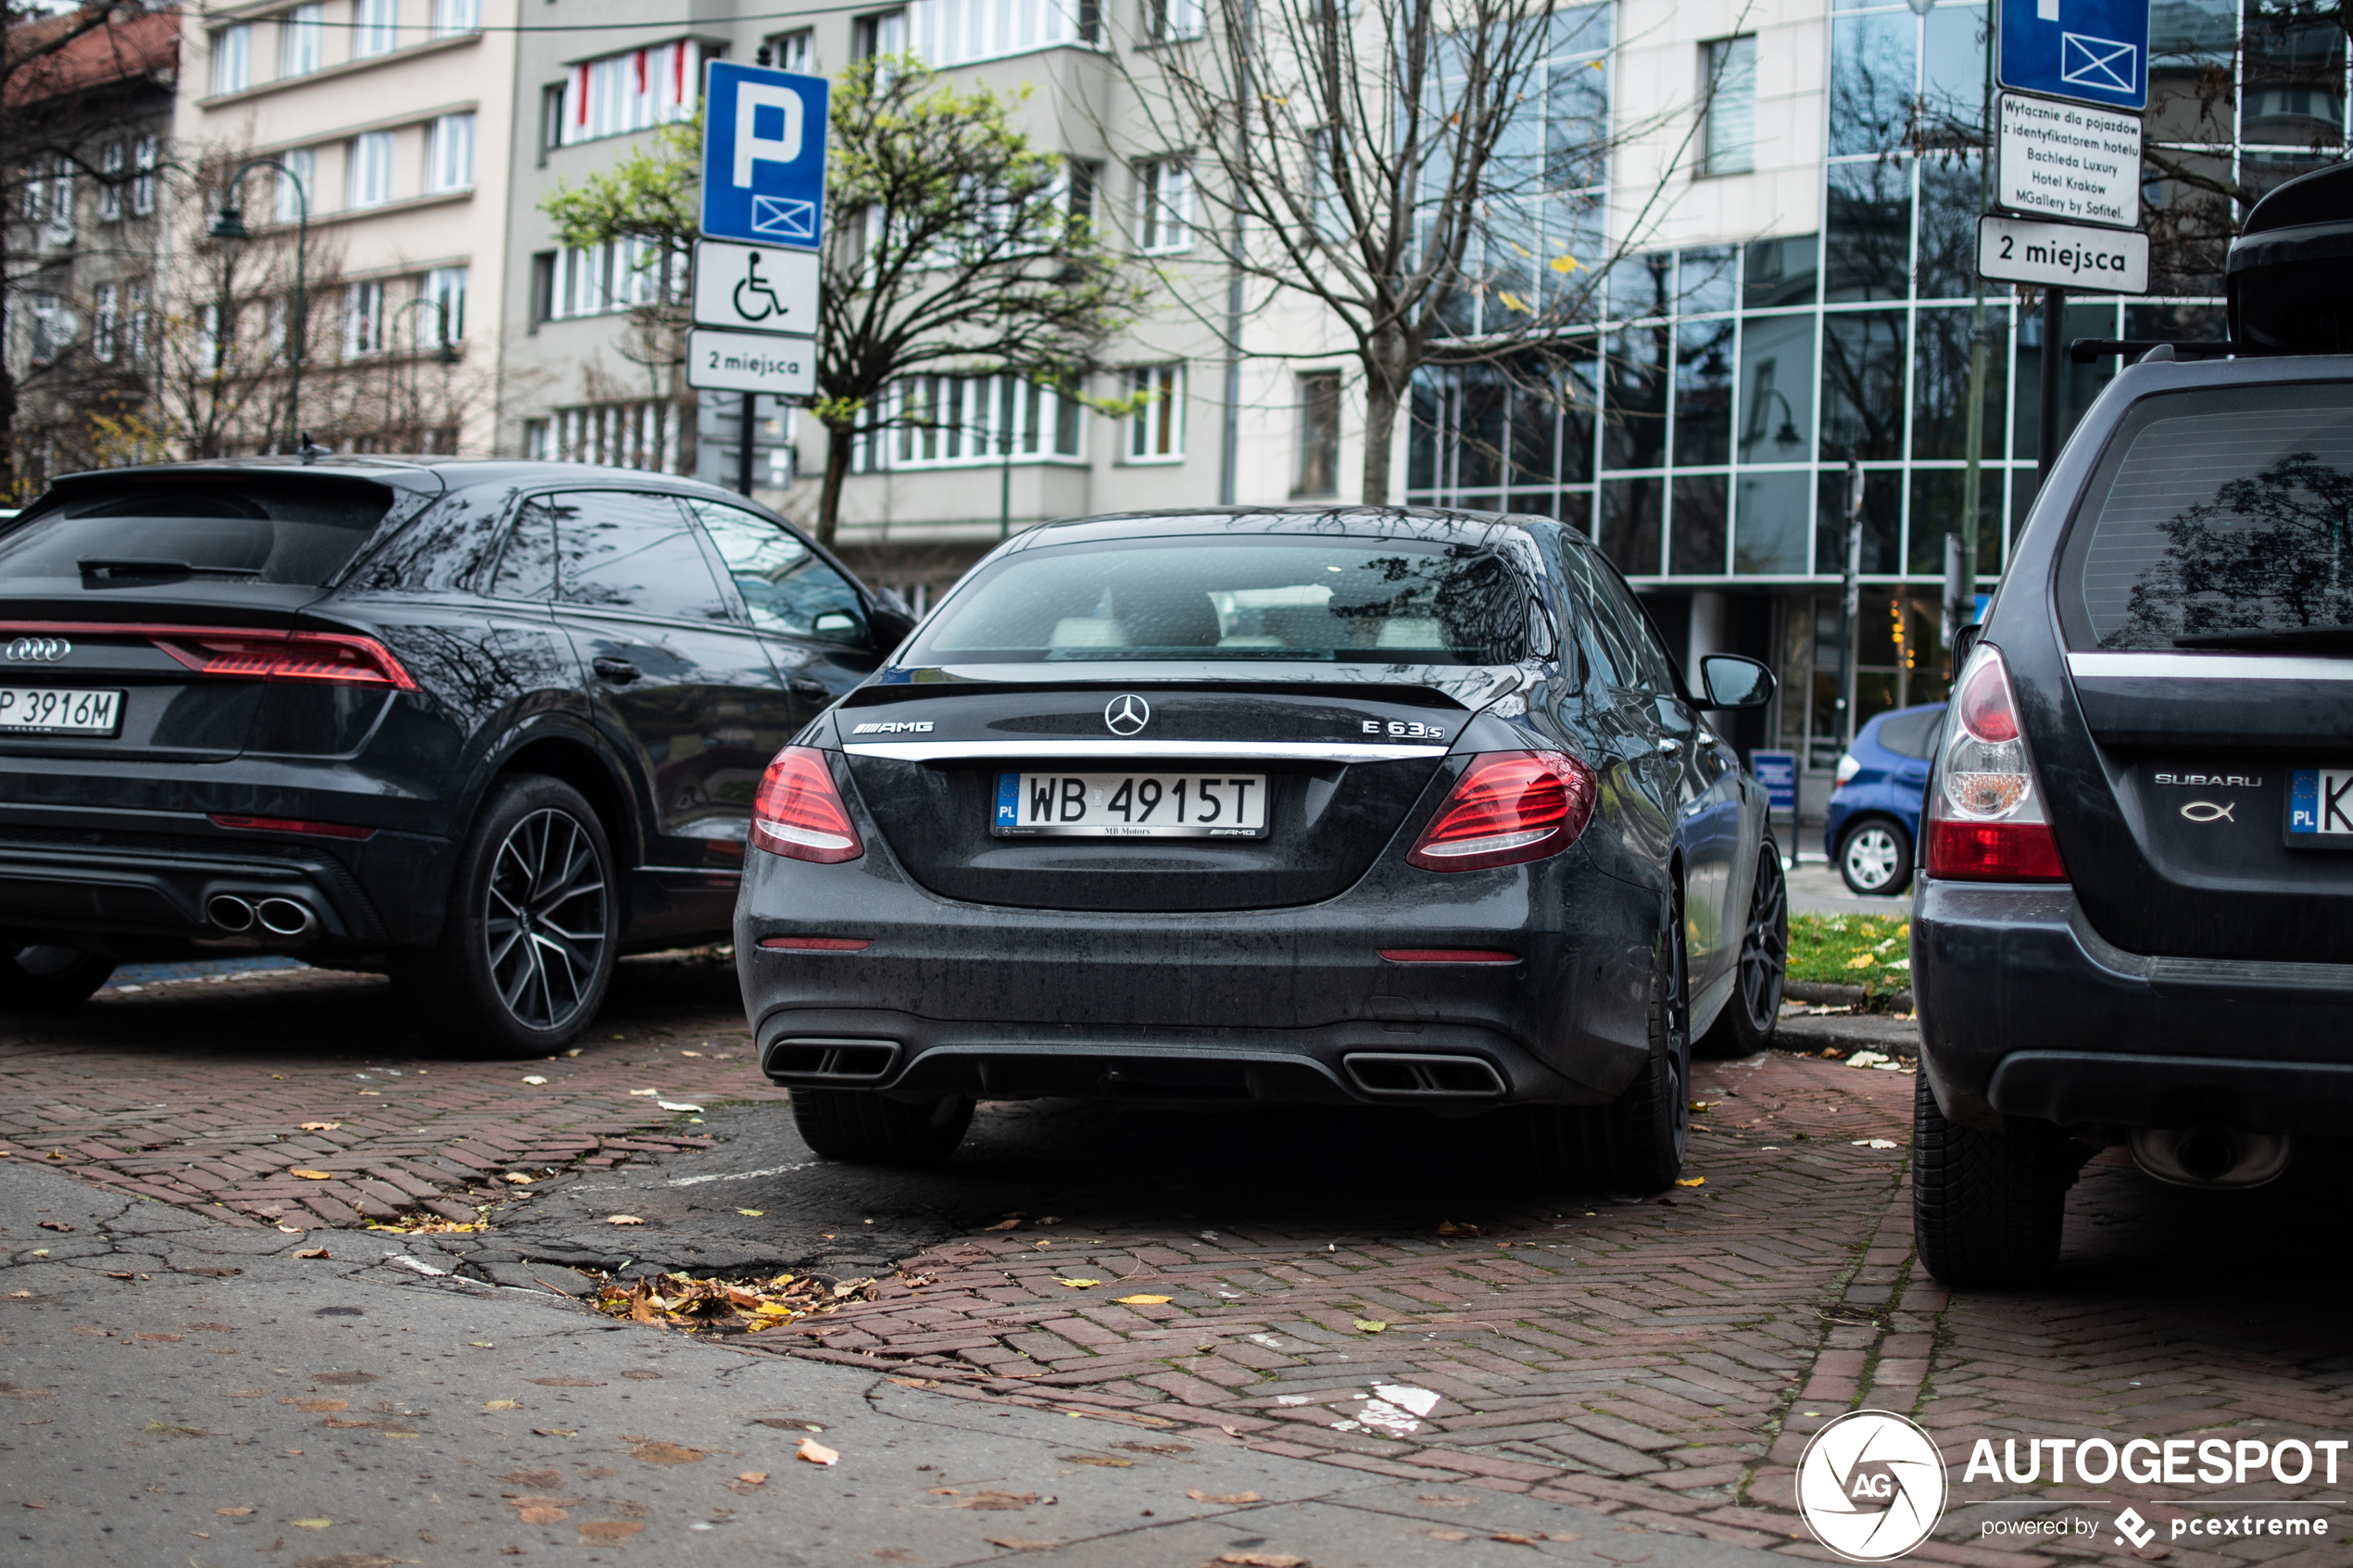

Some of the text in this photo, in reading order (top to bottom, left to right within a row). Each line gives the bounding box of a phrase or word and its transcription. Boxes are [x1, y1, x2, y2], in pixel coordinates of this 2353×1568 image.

[2004, 99, 2139, 136] Wyłącznie dla pojazdów
[733, 80, 804, 188] P
[2004, 123, 2139, 157] z identyfikatorem hotelu
[2027, 147, 2118, 178] Bachleda Luxury
[2032, 171, 2107, 196] Hotel Kraków
[2016, 190, 2124, 220] MGallery by Sofitel.
[1999, 235, 2126, 274] 2 miejsca
[708, 351, 799, 376] 2 miejsca
[23, 692, 111, 726] 3916M
[1362, 721, 1380, 734] E
[2154, 773, 2262, 787] SUBARU
[999, 806, 1015, 818] PL
[1030, 778, 1256, 824] WB 4915T
[1121, 827, 1151, 835] Motors
[2293, 810, 2314, 826] PL
